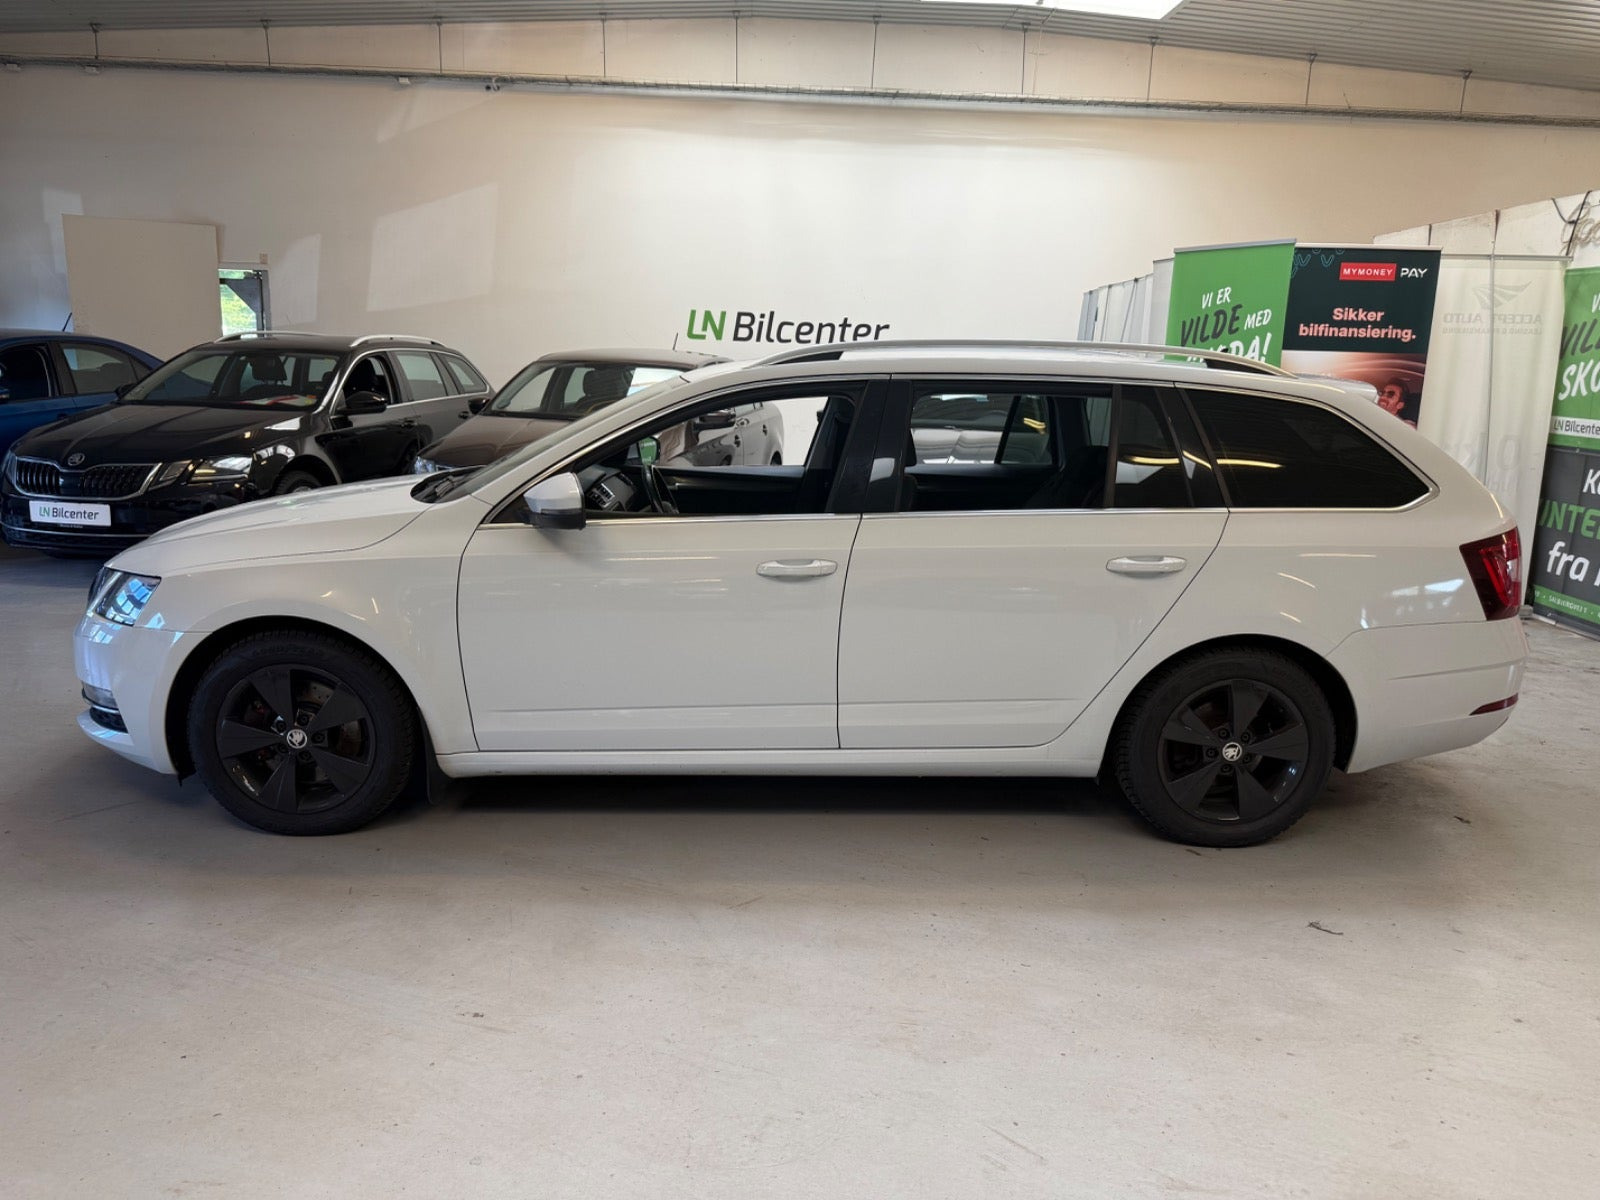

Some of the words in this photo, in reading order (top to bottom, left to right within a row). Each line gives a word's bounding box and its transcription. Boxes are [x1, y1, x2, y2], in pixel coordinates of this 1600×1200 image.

[1343, 268, 1393, 276] MYMONEY
[1400, 267, 1428, 278] PAY
[1202, 292, 1213, 309] VI
[1216, 287, 1231, 305] ER
[1332, 307, 1384, 321] Sikker
[687, 309, 727, 341] LN
[732, 310, 890, 344] Bilcenter
[1181, 304, 1243, 347] VILDE
[1244, 309, 1271, 330] MED
[1299, 323, 1417, 342] bilfinansiering.
[1558, 359, 1600, 400] SKO
[1564, 420, 1600, 436] Bilcente
[39, 506, 50, 518] LN
[52, 507, 99, 520] Bilcenter
[1539, 498, 1600, 541] INTE
[1546, 541, 1590, 582] fra
